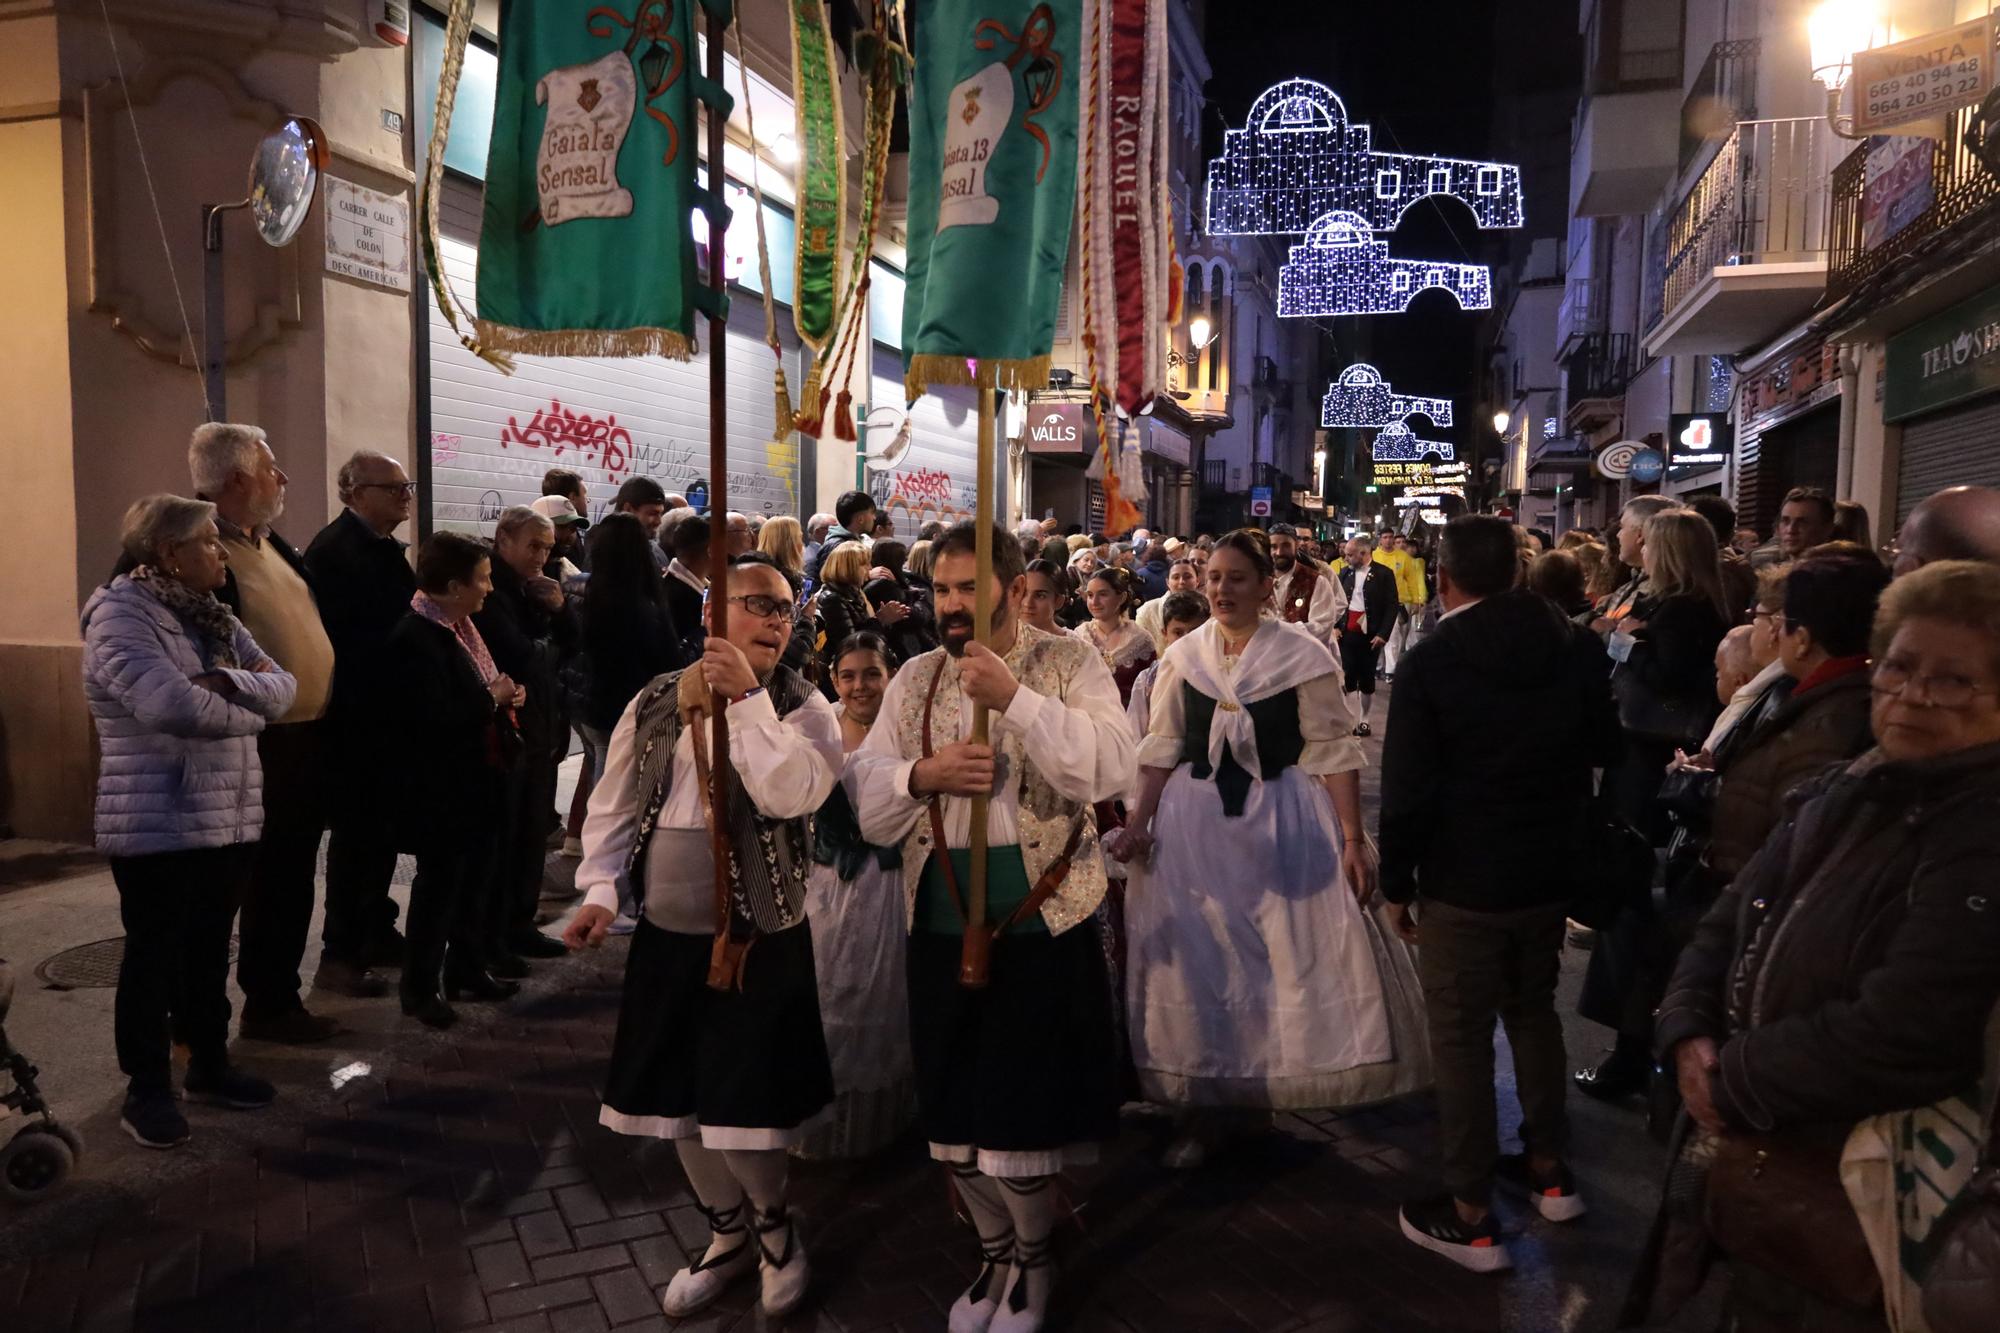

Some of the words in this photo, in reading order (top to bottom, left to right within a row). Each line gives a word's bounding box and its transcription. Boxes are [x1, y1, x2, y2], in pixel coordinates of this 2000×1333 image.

[1885, 43, 1965, 76] VENTA
[1870, 81, 1900, 98] 669
[1905, 73, 1926, 88] 40
[1931, 66, 1952, 81] 94
[1957, 58, 1978, 73] 48
[1870, 98, 1900, 116] 964
[1906, 91, 1926, 108] 20
[1932, 83, 1952, 100] 50
[1958, 76, 1978, 93] 22
[387, 112, 400, 129] 49
[971, 138, 989, 163] 13
[1115, 96, 1141, 228] RAQUEL
[540, 157, 608, 194] Sensal
[340, 200, 368, 217] CARRER
[374, 211, 395, 226] CALLE
[363, 226, 374, 238] DE
[332, 260, 353, 274] DESC
[358, 267, 399, 287] AMERICAS
[1921, 343, 1952, 378] TEA
[1031, 426, 1076, 442] VALLS
